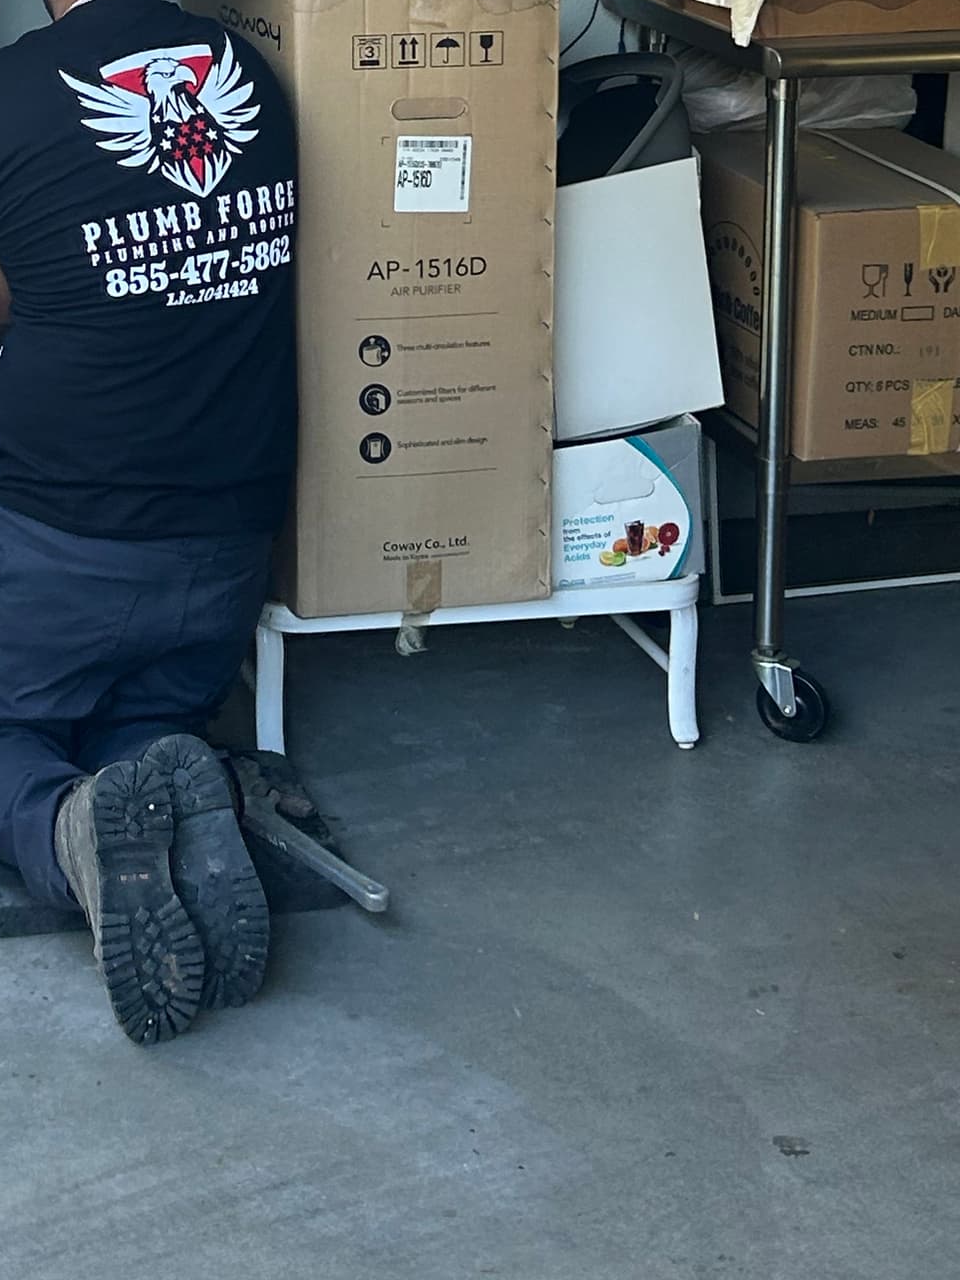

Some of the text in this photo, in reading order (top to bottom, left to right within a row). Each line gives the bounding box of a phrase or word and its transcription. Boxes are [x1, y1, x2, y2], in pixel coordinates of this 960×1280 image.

[81, 180, 295, 254] PLUMB FORCE
[91, 235, 197, 267] PLUMBING
[206, 226, 238, 245] AND
[105, 234, 291, 298] 855-477-5862
[366, 256, 488, 281] AP-1516D
[390, 283, 462, 297] AIR PURIFIER
[850, 308, 898, 321] MEDIUM
[848, 344, 874, 357] CTN
[885, 379, 910, 392] PCS
[562, 514, 615, 527] Protection
[383, 541, 423, 553] Coway
[563, 541, 607, 553] Everyday
[564, 553, 591, 563] Acids
